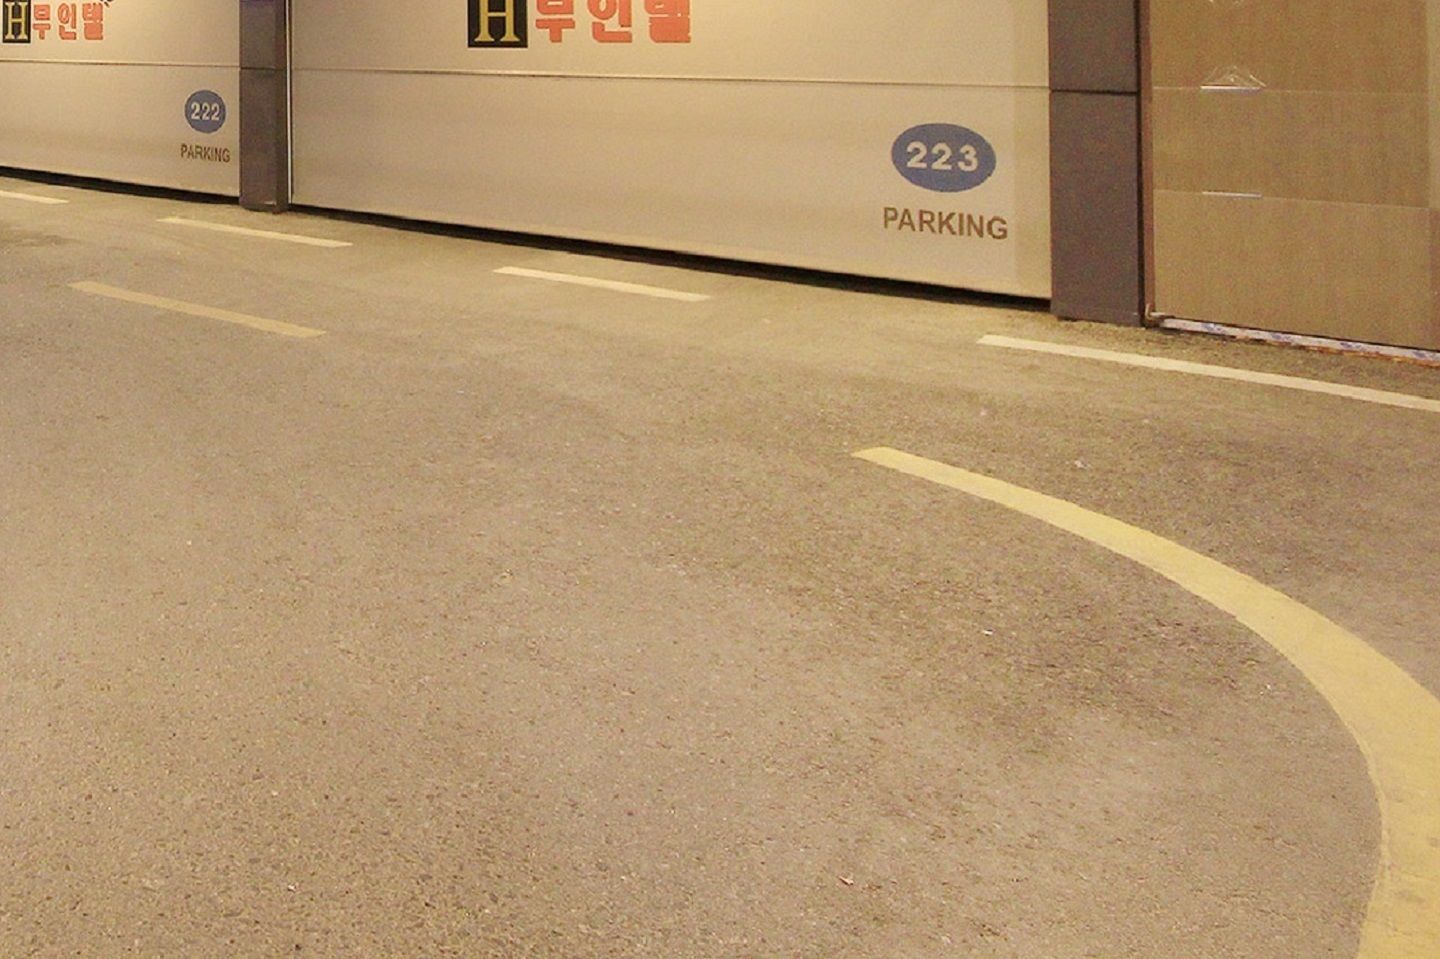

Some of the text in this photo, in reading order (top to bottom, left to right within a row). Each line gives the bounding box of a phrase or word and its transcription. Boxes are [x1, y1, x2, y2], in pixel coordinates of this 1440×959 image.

[190, 101, 220, 122] 222
[180, 143, 231, 163] PARKING
[906, 140, 979, 172] 223
[883, 206, 1008, 240] PARKING
